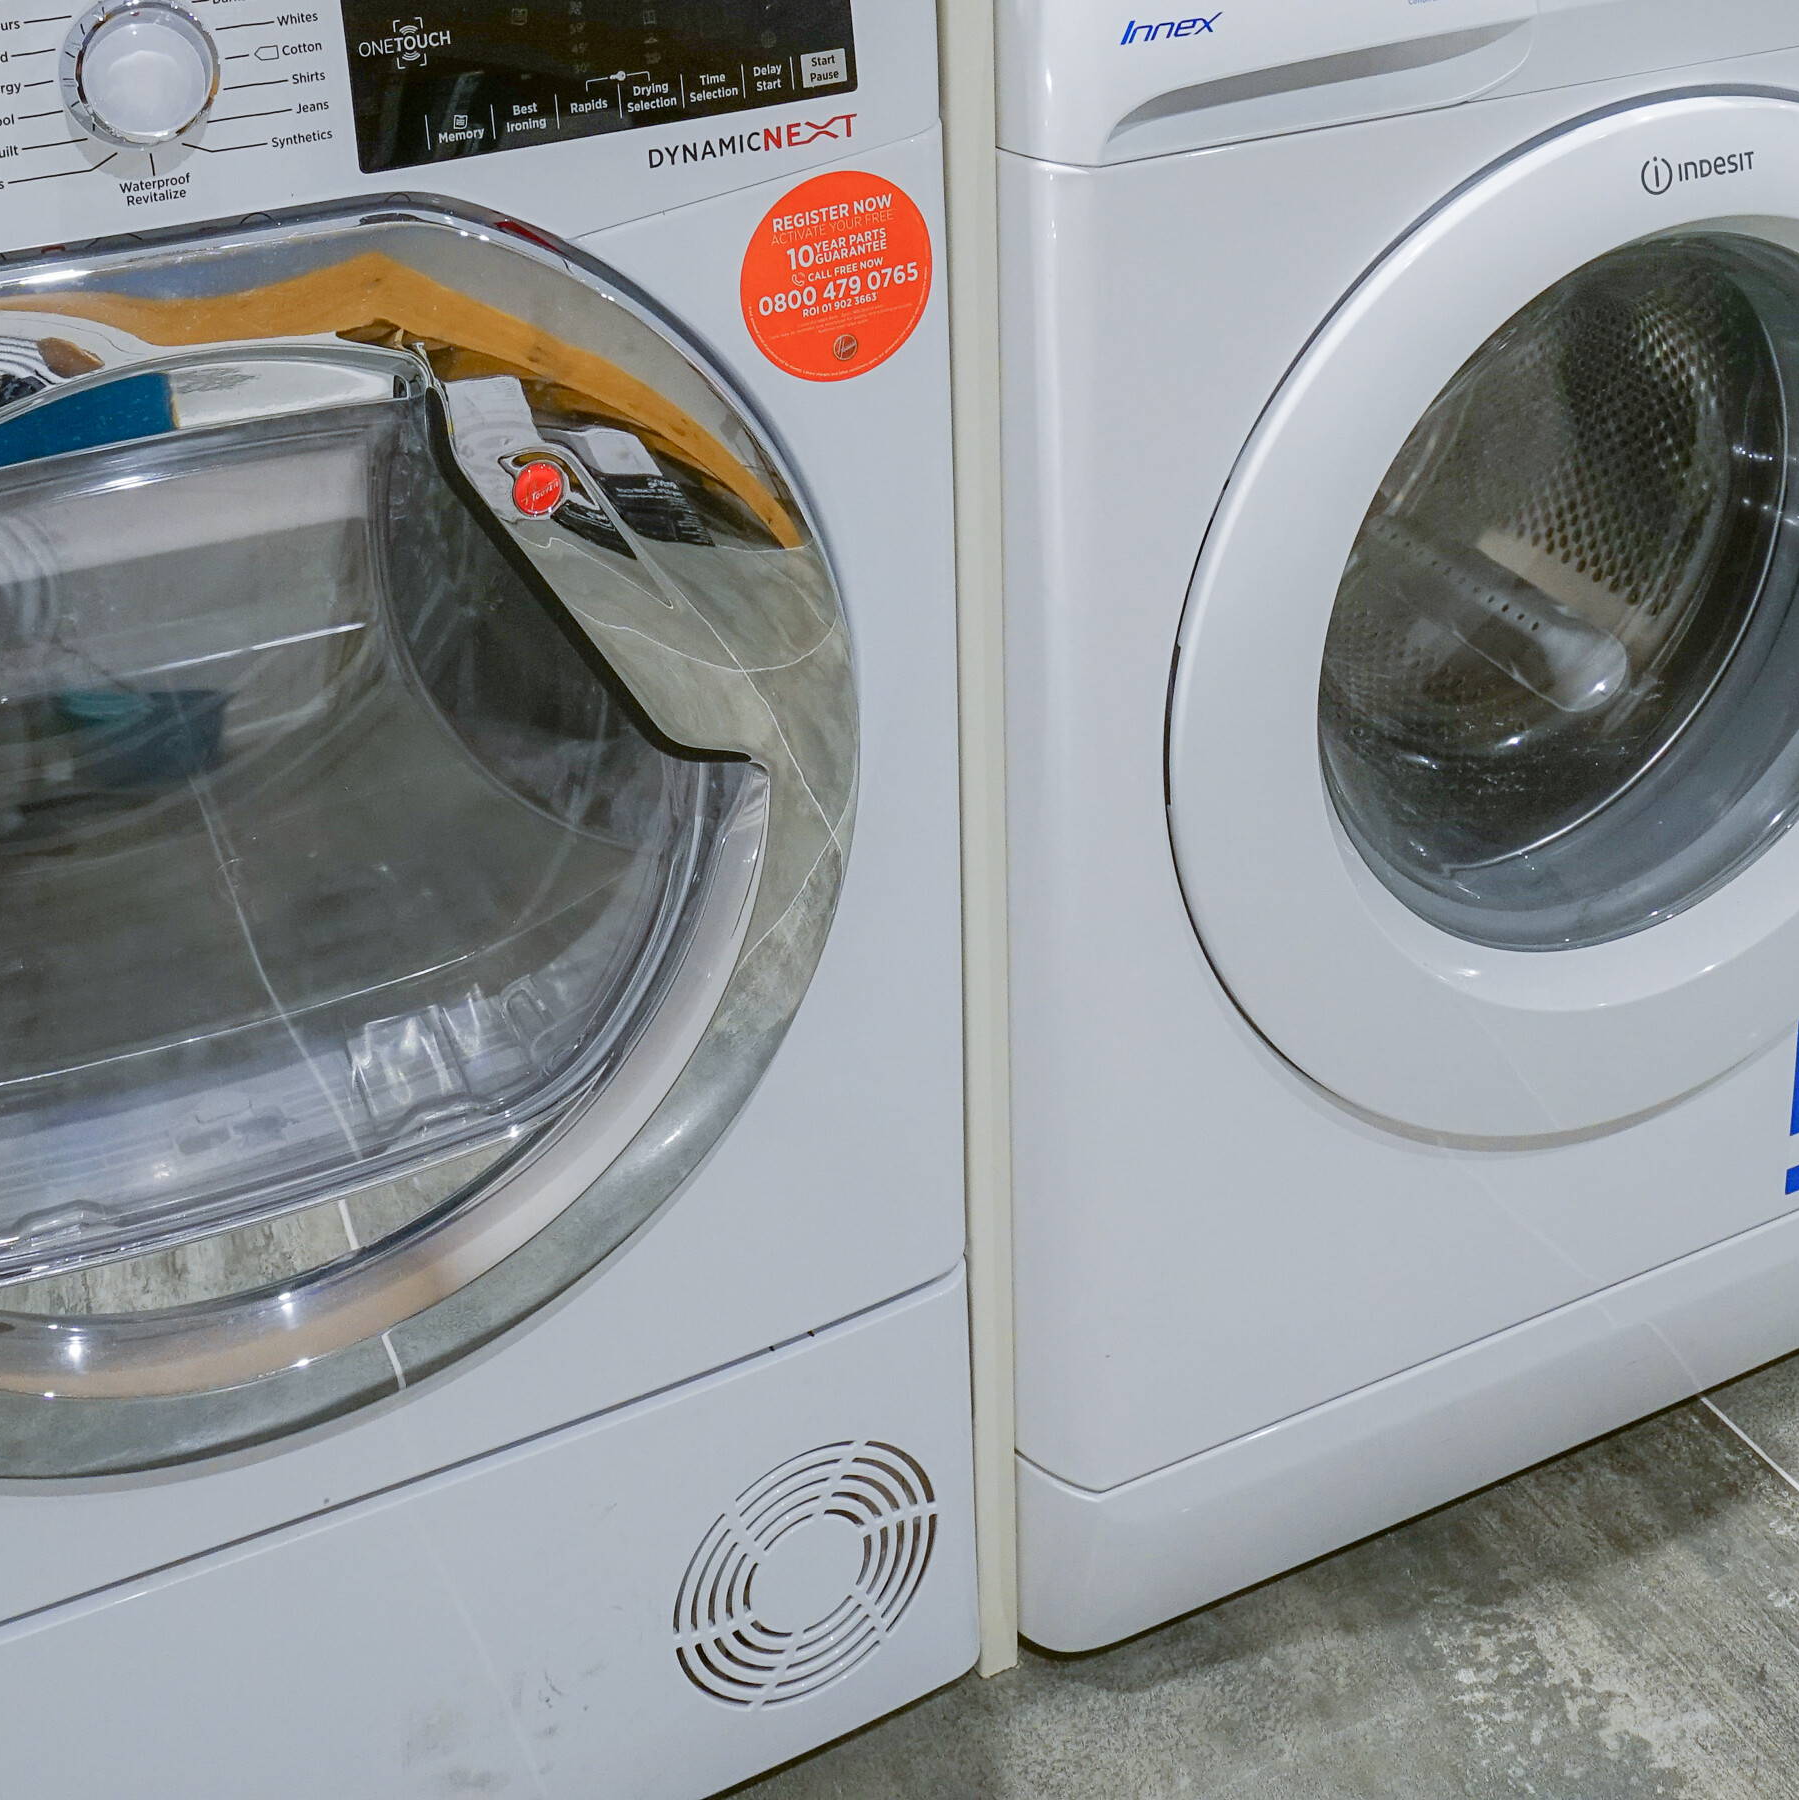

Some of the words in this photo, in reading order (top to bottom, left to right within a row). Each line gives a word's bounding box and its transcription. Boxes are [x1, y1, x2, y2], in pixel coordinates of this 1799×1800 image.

[276, 12, 319, 27] Whites
[1120, 11, 1224, 46] Innex
[282, 42, 323, 56] Cotton
[358, 30, 451, 58] ONETOUCH
[811, 54, 836, 68] Start
[292, 70, 326, 85] Shirts
[753, 63, 782, 77] Delay
[809, 69, 840, 83] Pause
[699, 72, 726, 86] Time
[756, 78, 782, 92] Start
[632, 81, 669, 97] Drying
[689, 85, 739, 103] Selection
[296, 100, 330, 114] Jeans
[512, 102, 538, 116] Best
[569, 98, 608, 114] Rapids
[627, 95, 678, 113] Selection
[506, 117, 547, 133] Ironing
[271, 129, 333, 149] Synthetics
[438, 128, 485, 144] Memory
[119, 172, 191, 194] Waterproof
[126, 188, 187, 207] Revitalize
[772, 203, 850, 234] REGISTER
[853, 193, 893, 215] NOW
[771, 224, 827, 247] ACTIVATE
[829, 216, 862, 233] YOUR
[786, 244, 815, 270] 10
[813, 236, 847, 253] YEAR
[848, 228, 887, 245] PARTS
[814, 239, 888, 266] GUARANTEE
[807, 270, 832, 282] CALL
[834, 262, 858, 277] FREE
[859, 256, 884, 270] NOW
[758, 285, 817, 317] 0800
[822, 275, 861, 301] 479
[867, 261, 919, 290] 0765
[802, 306, 820, 318] ROI
[821, 303, 832, 313] 01
[834, 298, 852, 310] 902
